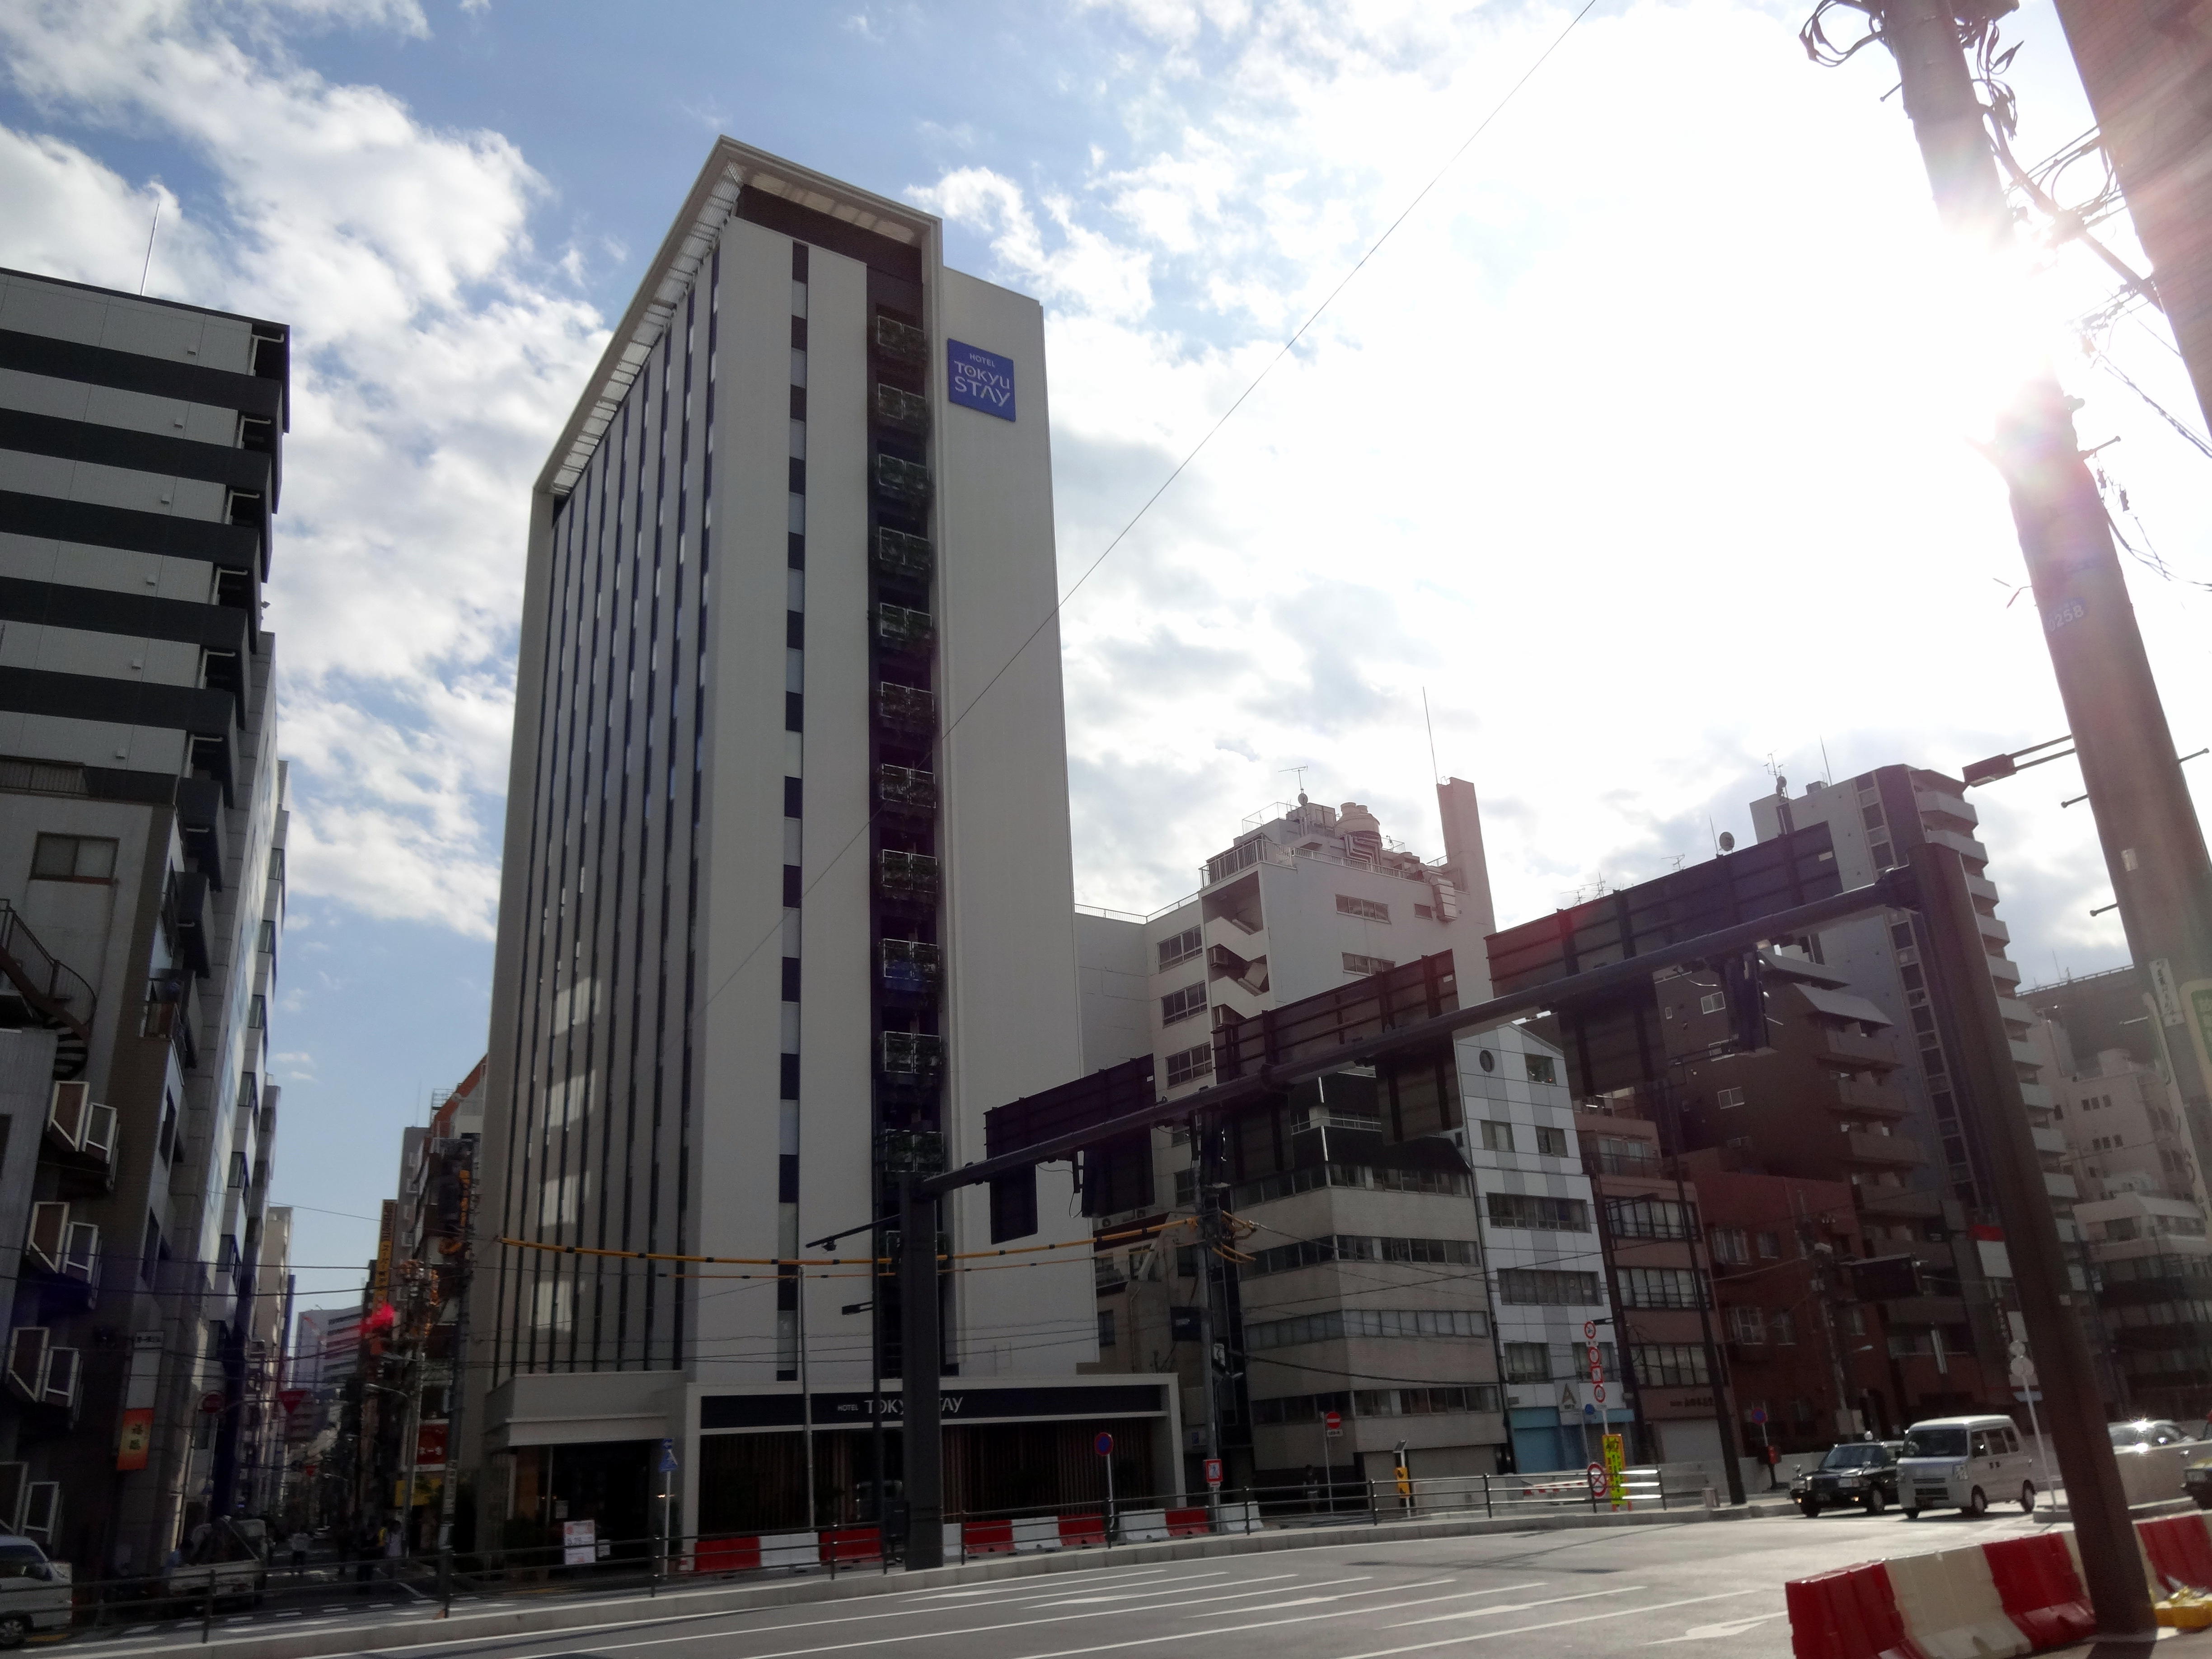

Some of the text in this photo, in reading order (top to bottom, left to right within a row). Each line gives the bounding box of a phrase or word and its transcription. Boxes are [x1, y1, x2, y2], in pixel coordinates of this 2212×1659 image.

[970, 353, 995, 367] HOTEL
[954, 361, 1009, 389] TOKYU
[955, 376, 1010, 407] STAY
[864, 1399, 903, 1415] TOKY
